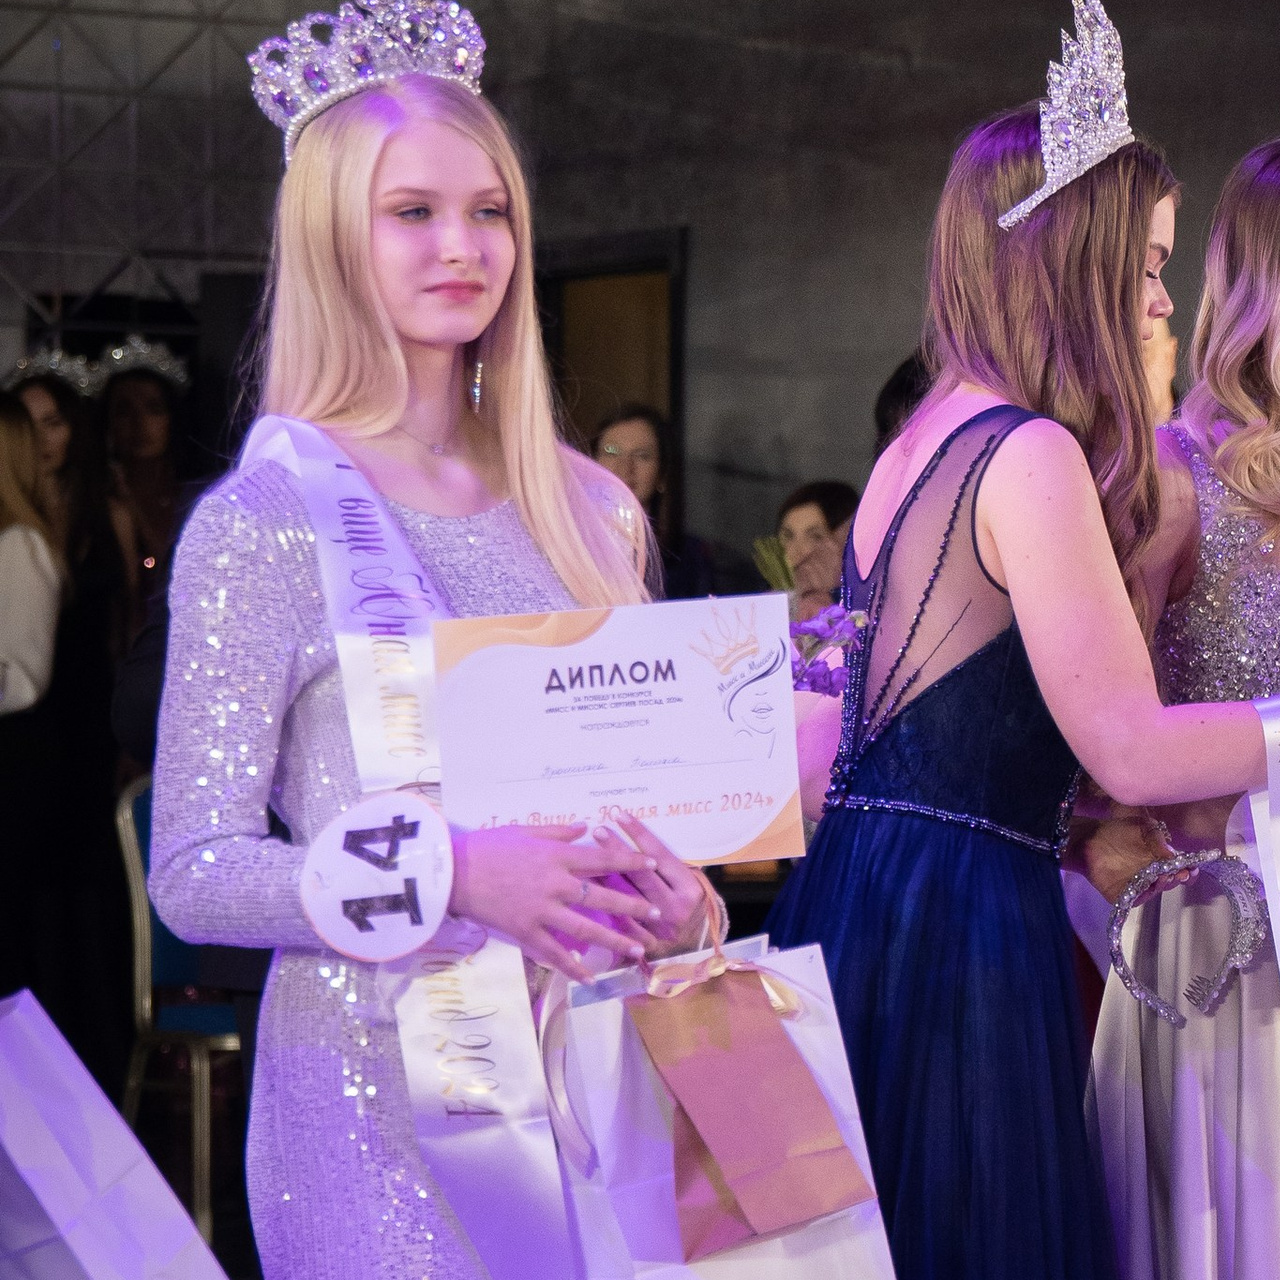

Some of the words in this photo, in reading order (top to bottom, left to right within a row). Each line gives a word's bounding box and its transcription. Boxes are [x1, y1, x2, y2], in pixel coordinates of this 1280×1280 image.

[545, 659, 677, 694] ДИПЛОМ
[666, 800, 712, 817] мисс
[720, 792, 774, 813] 2024»
[342, 814, 424, 933] 14
